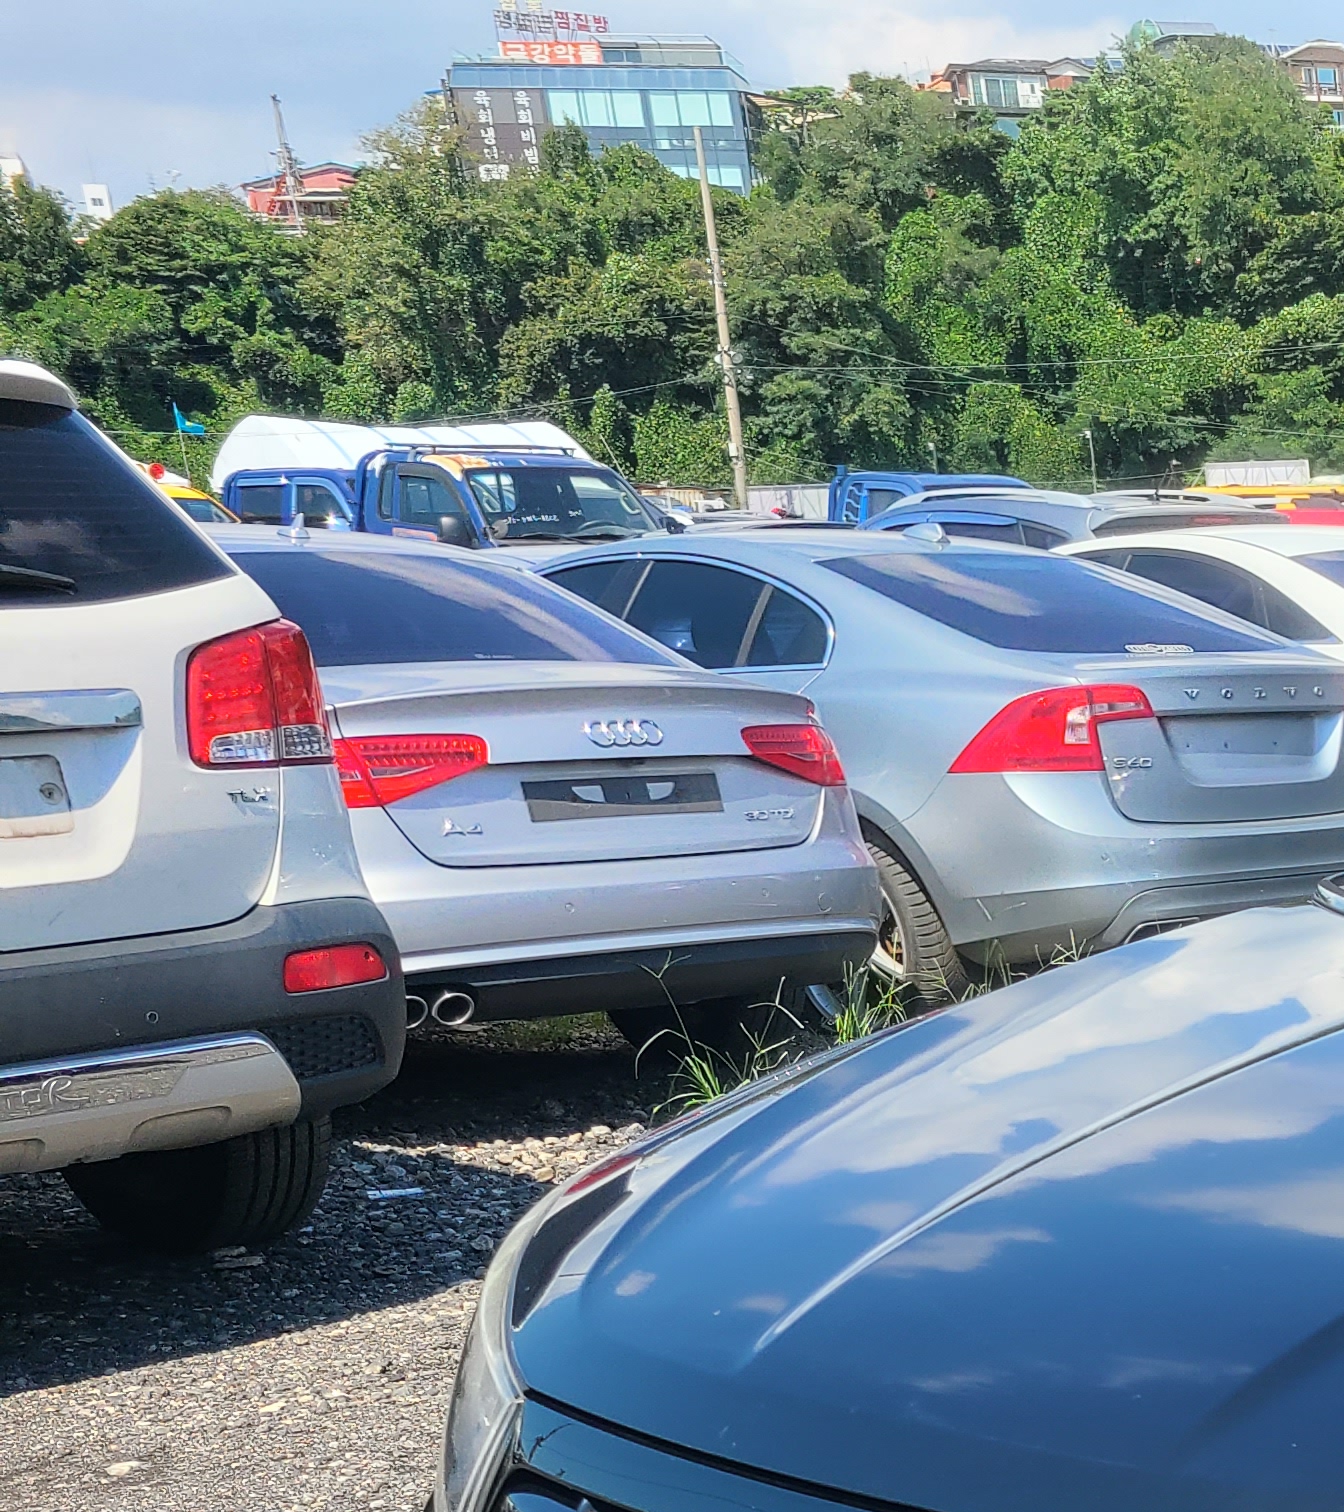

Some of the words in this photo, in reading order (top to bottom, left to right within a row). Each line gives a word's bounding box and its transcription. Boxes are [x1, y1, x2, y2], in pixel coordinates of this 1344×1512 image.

[1184, 685, 1324, 700] VOLVO
[1113, 756, 1153, 769] S60
[442, 816, 483, 837] A4
